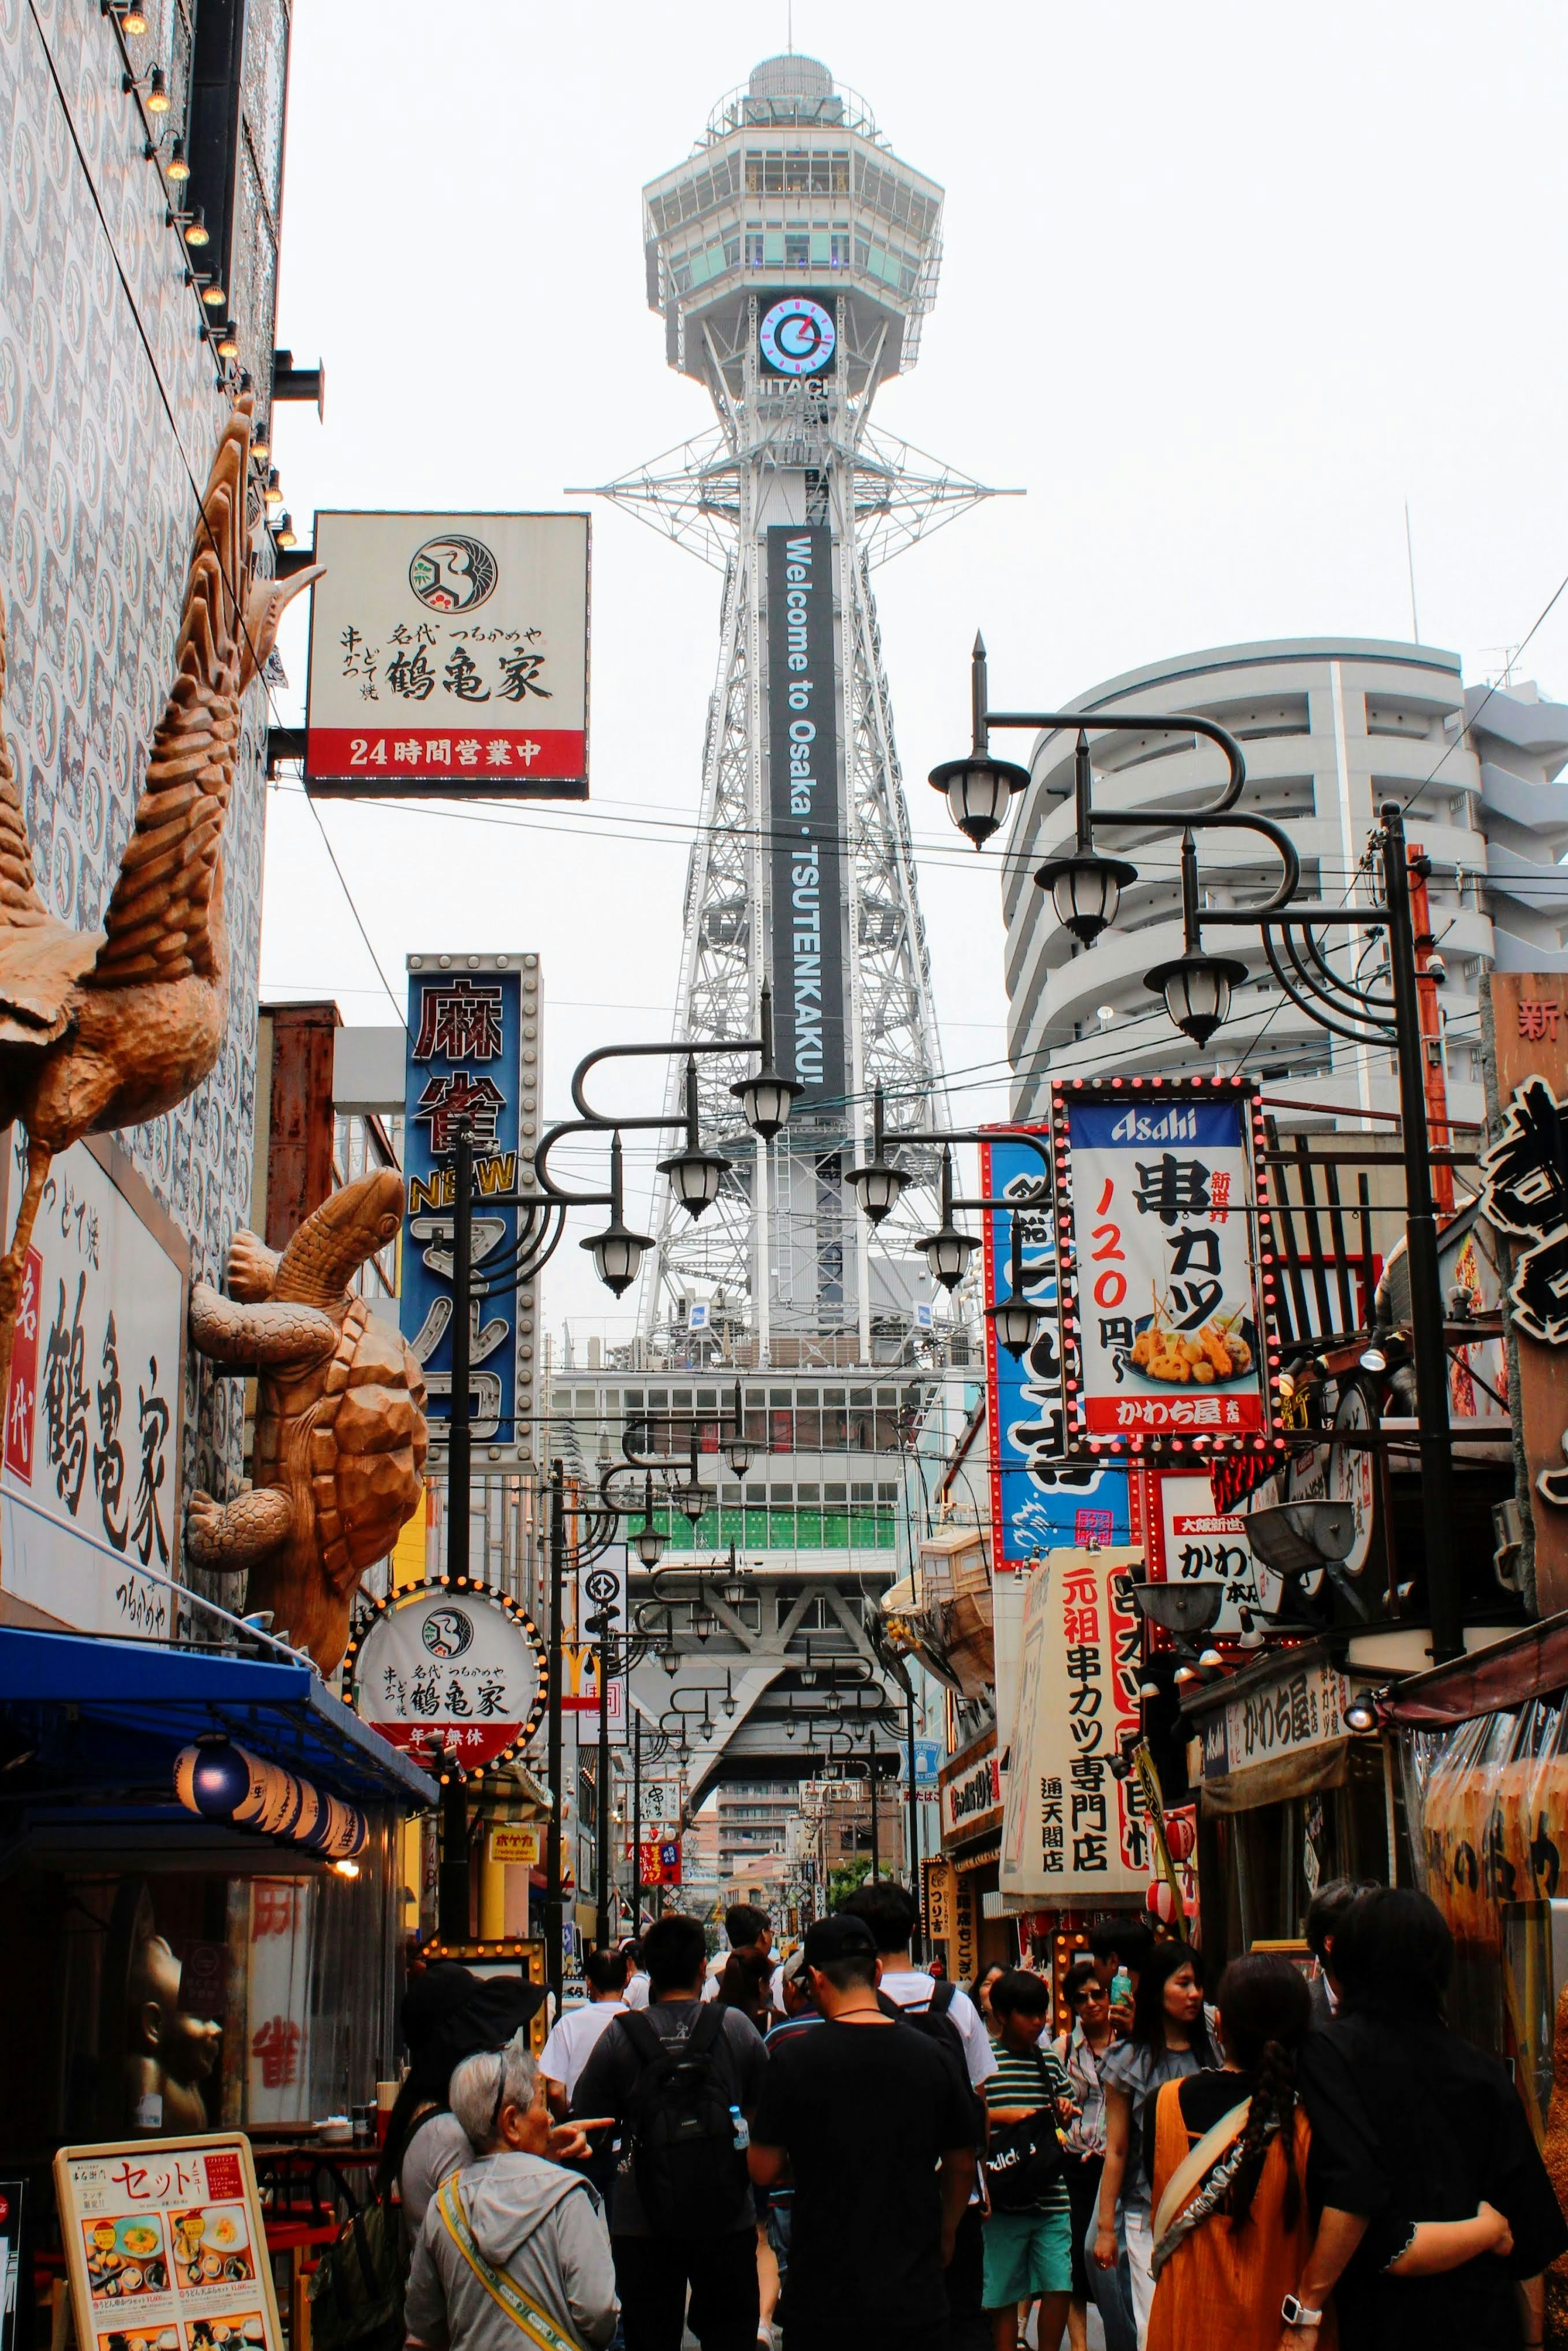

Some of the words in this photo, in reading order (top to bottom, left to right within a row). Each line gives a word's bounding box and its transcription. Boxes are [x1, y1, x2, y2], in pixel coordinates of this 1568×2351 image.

[785, 537, 812, 672] Welcome
[339, 626, 363, 679] 串かつ
[387, 623, 440, 645] 名代
[449, 627, 542, 645] つるかめや
[359, 646, 381, 701] どて焼
[385, 645, 553, 703] 鶴亀家
[789, 679, 811, 710] to
[350, 738, 543, 767] 24時間営業中
[788, 719, 816, 815] Osaka
[791, 845, 824, 1085] TSUTENKAKU!
[410, 979, 507, 1153] 麻雀
[1111, 1108, 1197, 1141] Asahi
[408, 1150, 518, 1215] NEW
[1210, 1171, 1232, 1224] 新世界
[1132, 1153, 1224, 1330] 串カツ
[42, 1271, 169, 1573] 鶴亀家
[1116, 1398, 1223, 1426] かわち屋
[1225, 1400, 1240, 1424] 本店
[383, 1665, 397, 1702] 串かつ
[395, 1680, 408, 1717] どて焼
[410, 1678, 511, 1717] 鶴亀家
[411, 1665, 444, 1679] 名代
[448, 1667, 504, 1677] つるかめや
[1062, 1567, 1108, 1873] 元祖串カツ専門店
[1243, 1672, 1311, 1757] かわち屋
[1041, 1776, 1064, 1874] 通天閣店
[930, 1891, 943, 1933] つり吉
[112, 2161, 191, 2200] セット
